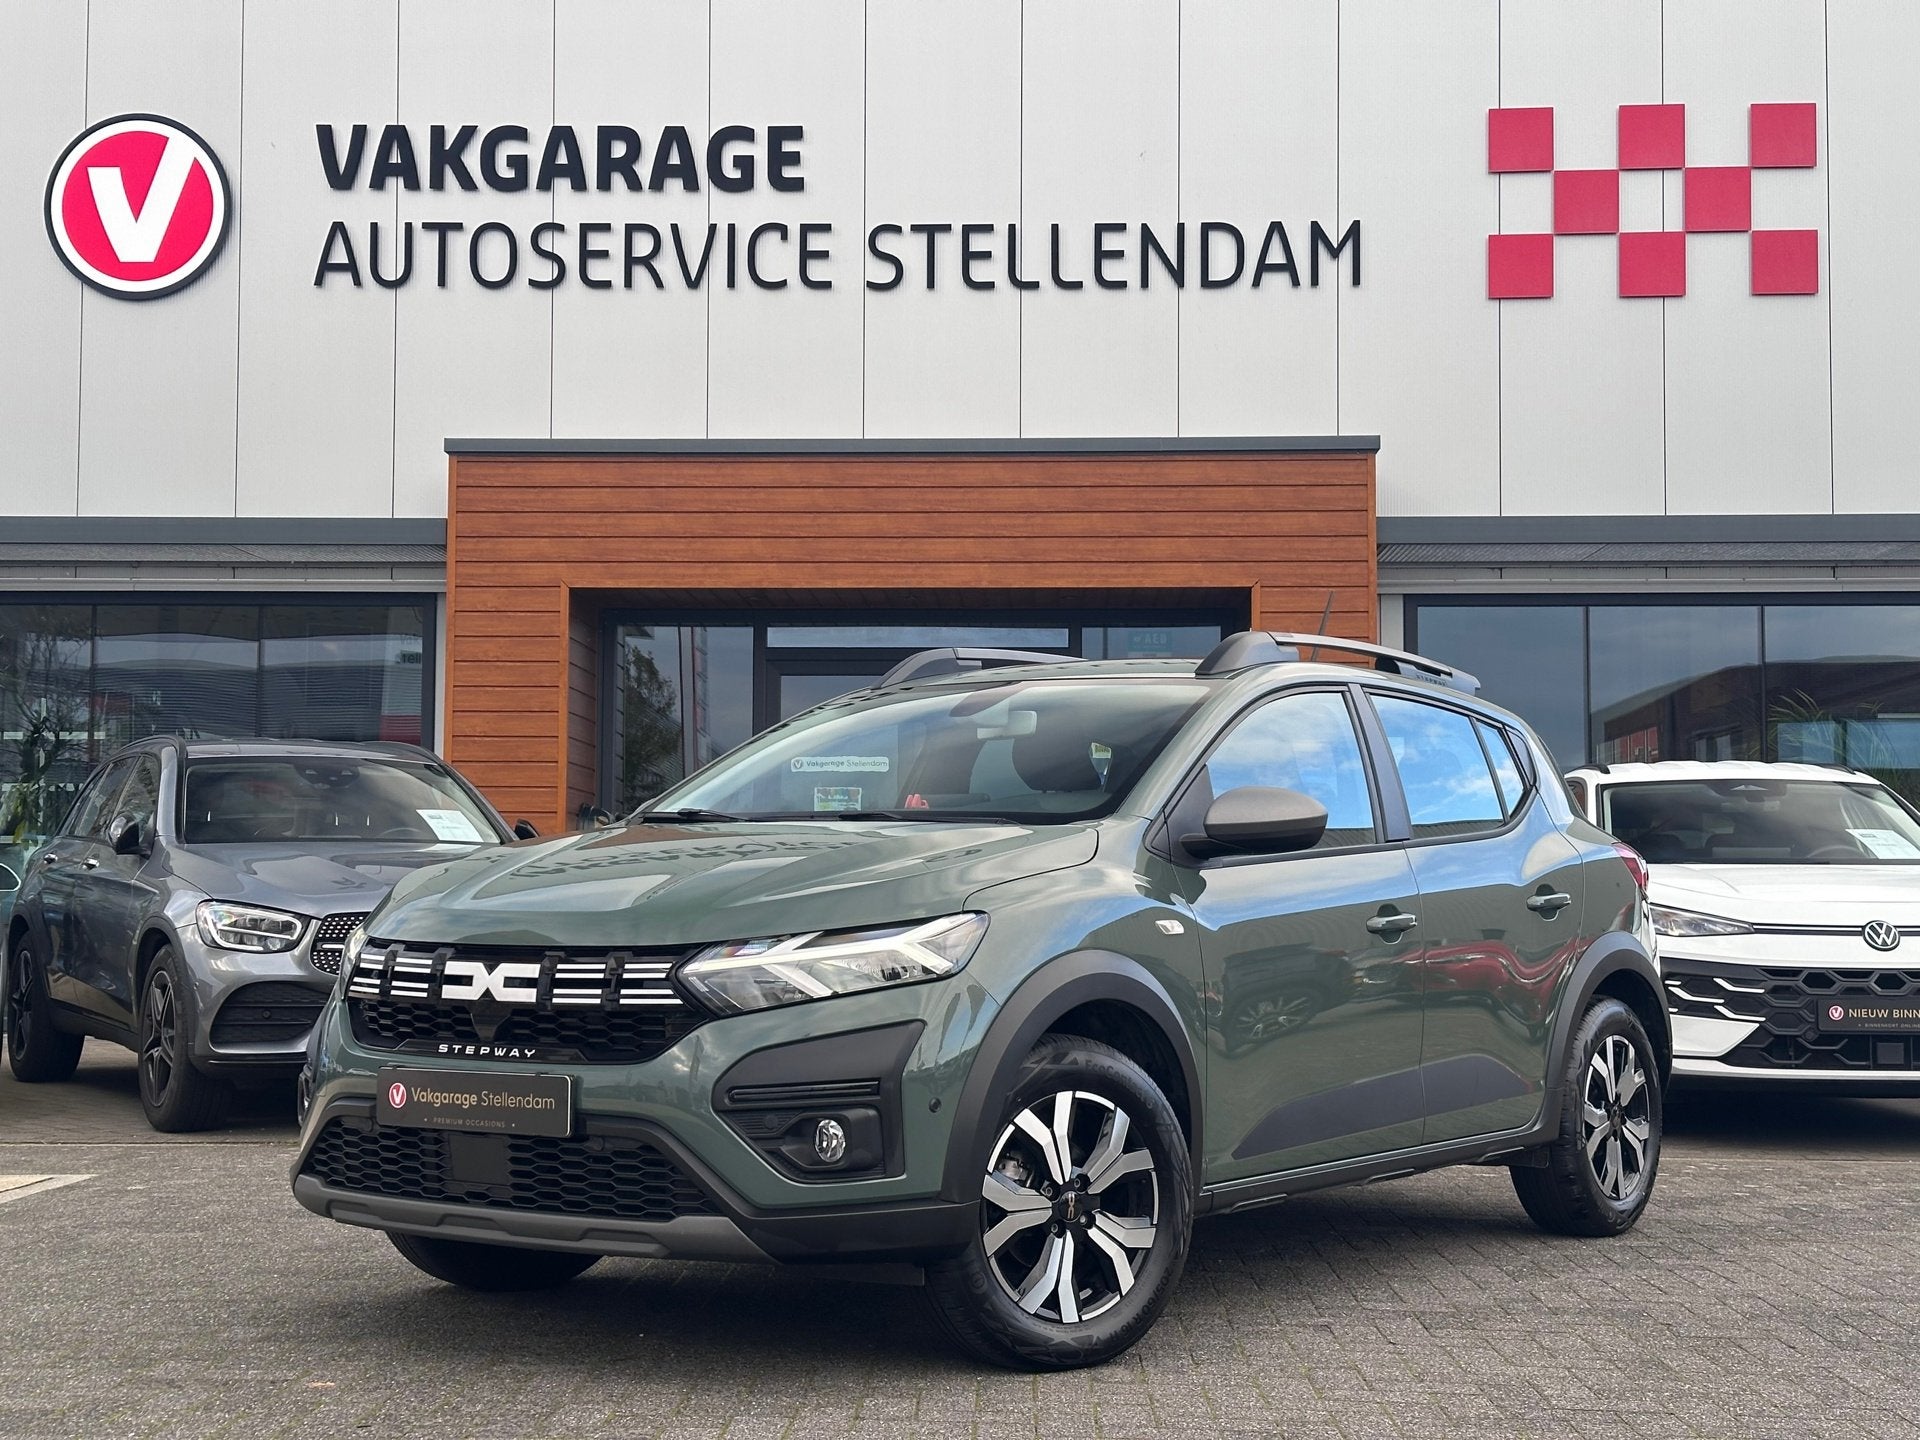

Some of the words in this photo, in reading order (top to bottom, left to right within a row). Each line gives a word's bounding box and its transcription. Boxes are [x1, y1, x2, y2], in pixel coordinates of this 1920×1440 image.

[316, 124, 804, 193] VAKGARAGE
[313, 221, 832, 290] AUTOSERVICE
[866, 219, 1361, 290] STELLENDAM
[1848, 1008, 1889, 1018] NIEUW
[1893, 1008, 1920, 1018] BINN
[438, 1044, 536, 1058] STEPWAY
[411, 1086, 478, 1109] Vakgarage
[480, 1090, 556, 1110] Stellendam
[433, 1117, 464, 1126] PREMIUM
[465, 1119, 506, 1128] OCCASIONS
